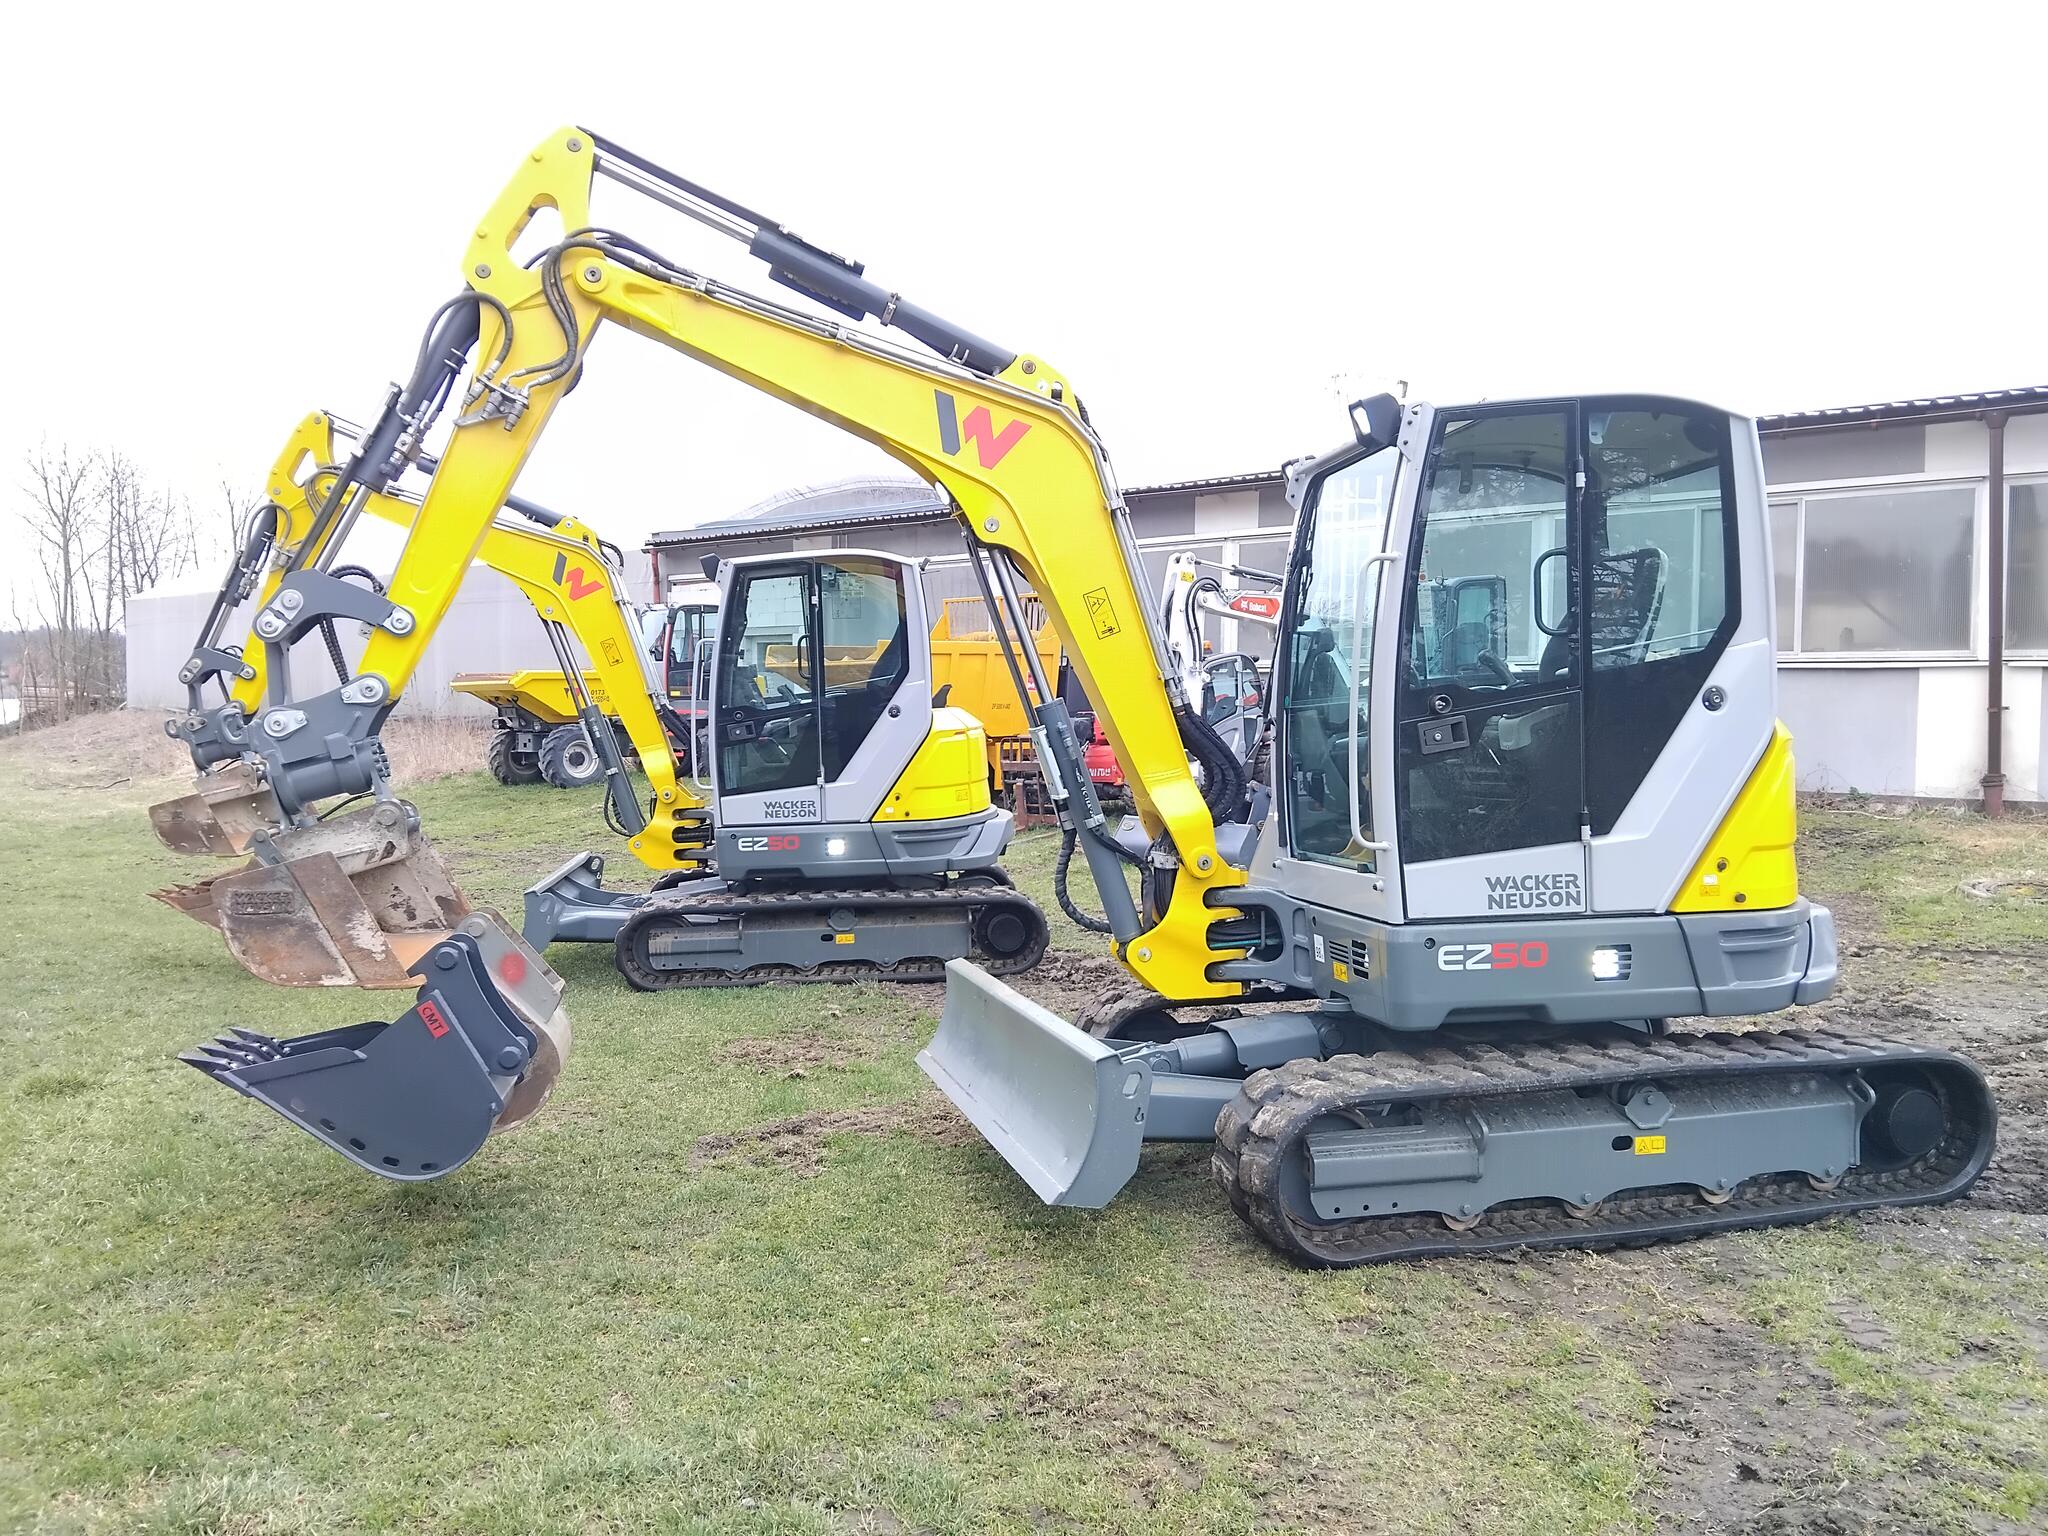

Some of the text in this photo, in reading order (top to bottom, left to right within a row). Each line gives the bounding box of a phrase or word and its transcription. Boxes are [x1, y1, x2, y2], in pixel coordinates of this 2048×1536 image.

[764, 800, 816, 810] WACKER
[765, 809, 817, 819] NEUSON
[738, 835, 800, 852] EZ50
[1485, 873, 1581, 893] WACKER
[1487, 890, 1581, 910] NEUSON
[1438, 941, 1548, 971] EZ50
[422, 1006, 444, 1031] CMT
